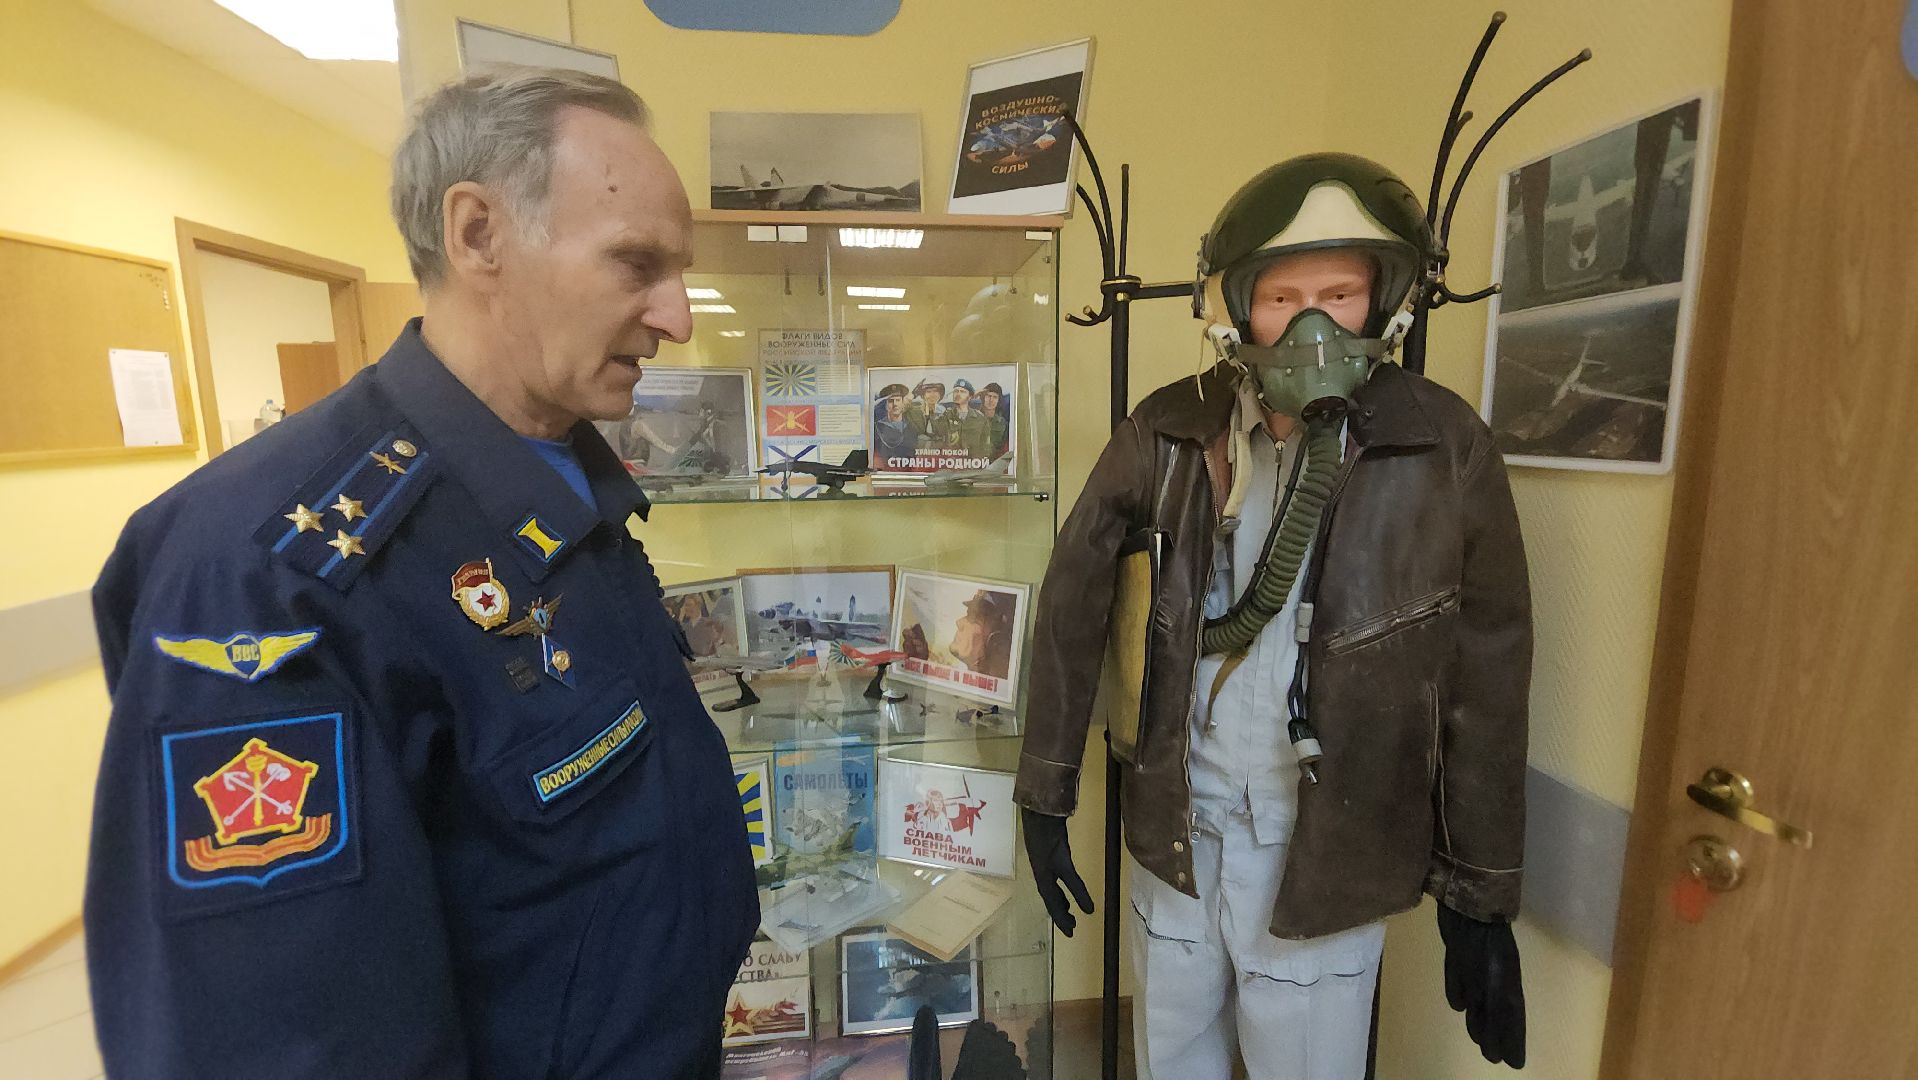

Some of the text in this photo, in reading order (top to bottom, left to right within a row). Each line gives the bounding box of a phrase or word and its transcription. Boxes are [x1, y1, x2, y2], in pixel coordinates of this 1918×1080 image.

[981, 95, 1060, 117] ВОЗДУШНО-
[992, 161, 1029, 174] СИЛЫ
[915, 448, 969, 456] ХРАНЮ ПОКОЙ
[887, 457, 990, 469] СТРАНЫ РОДНОЙ
[231, 644, 260, 662] ВВС
[539, 738, 611, 795] ВООРУЖЕННЫЕ
[905, 828, 953, 844] СЛАВА
[903, 836, 972, 855] ВОЕННЫМ
[912, 847, 987, 868] ЛЕТЧИКАМ
